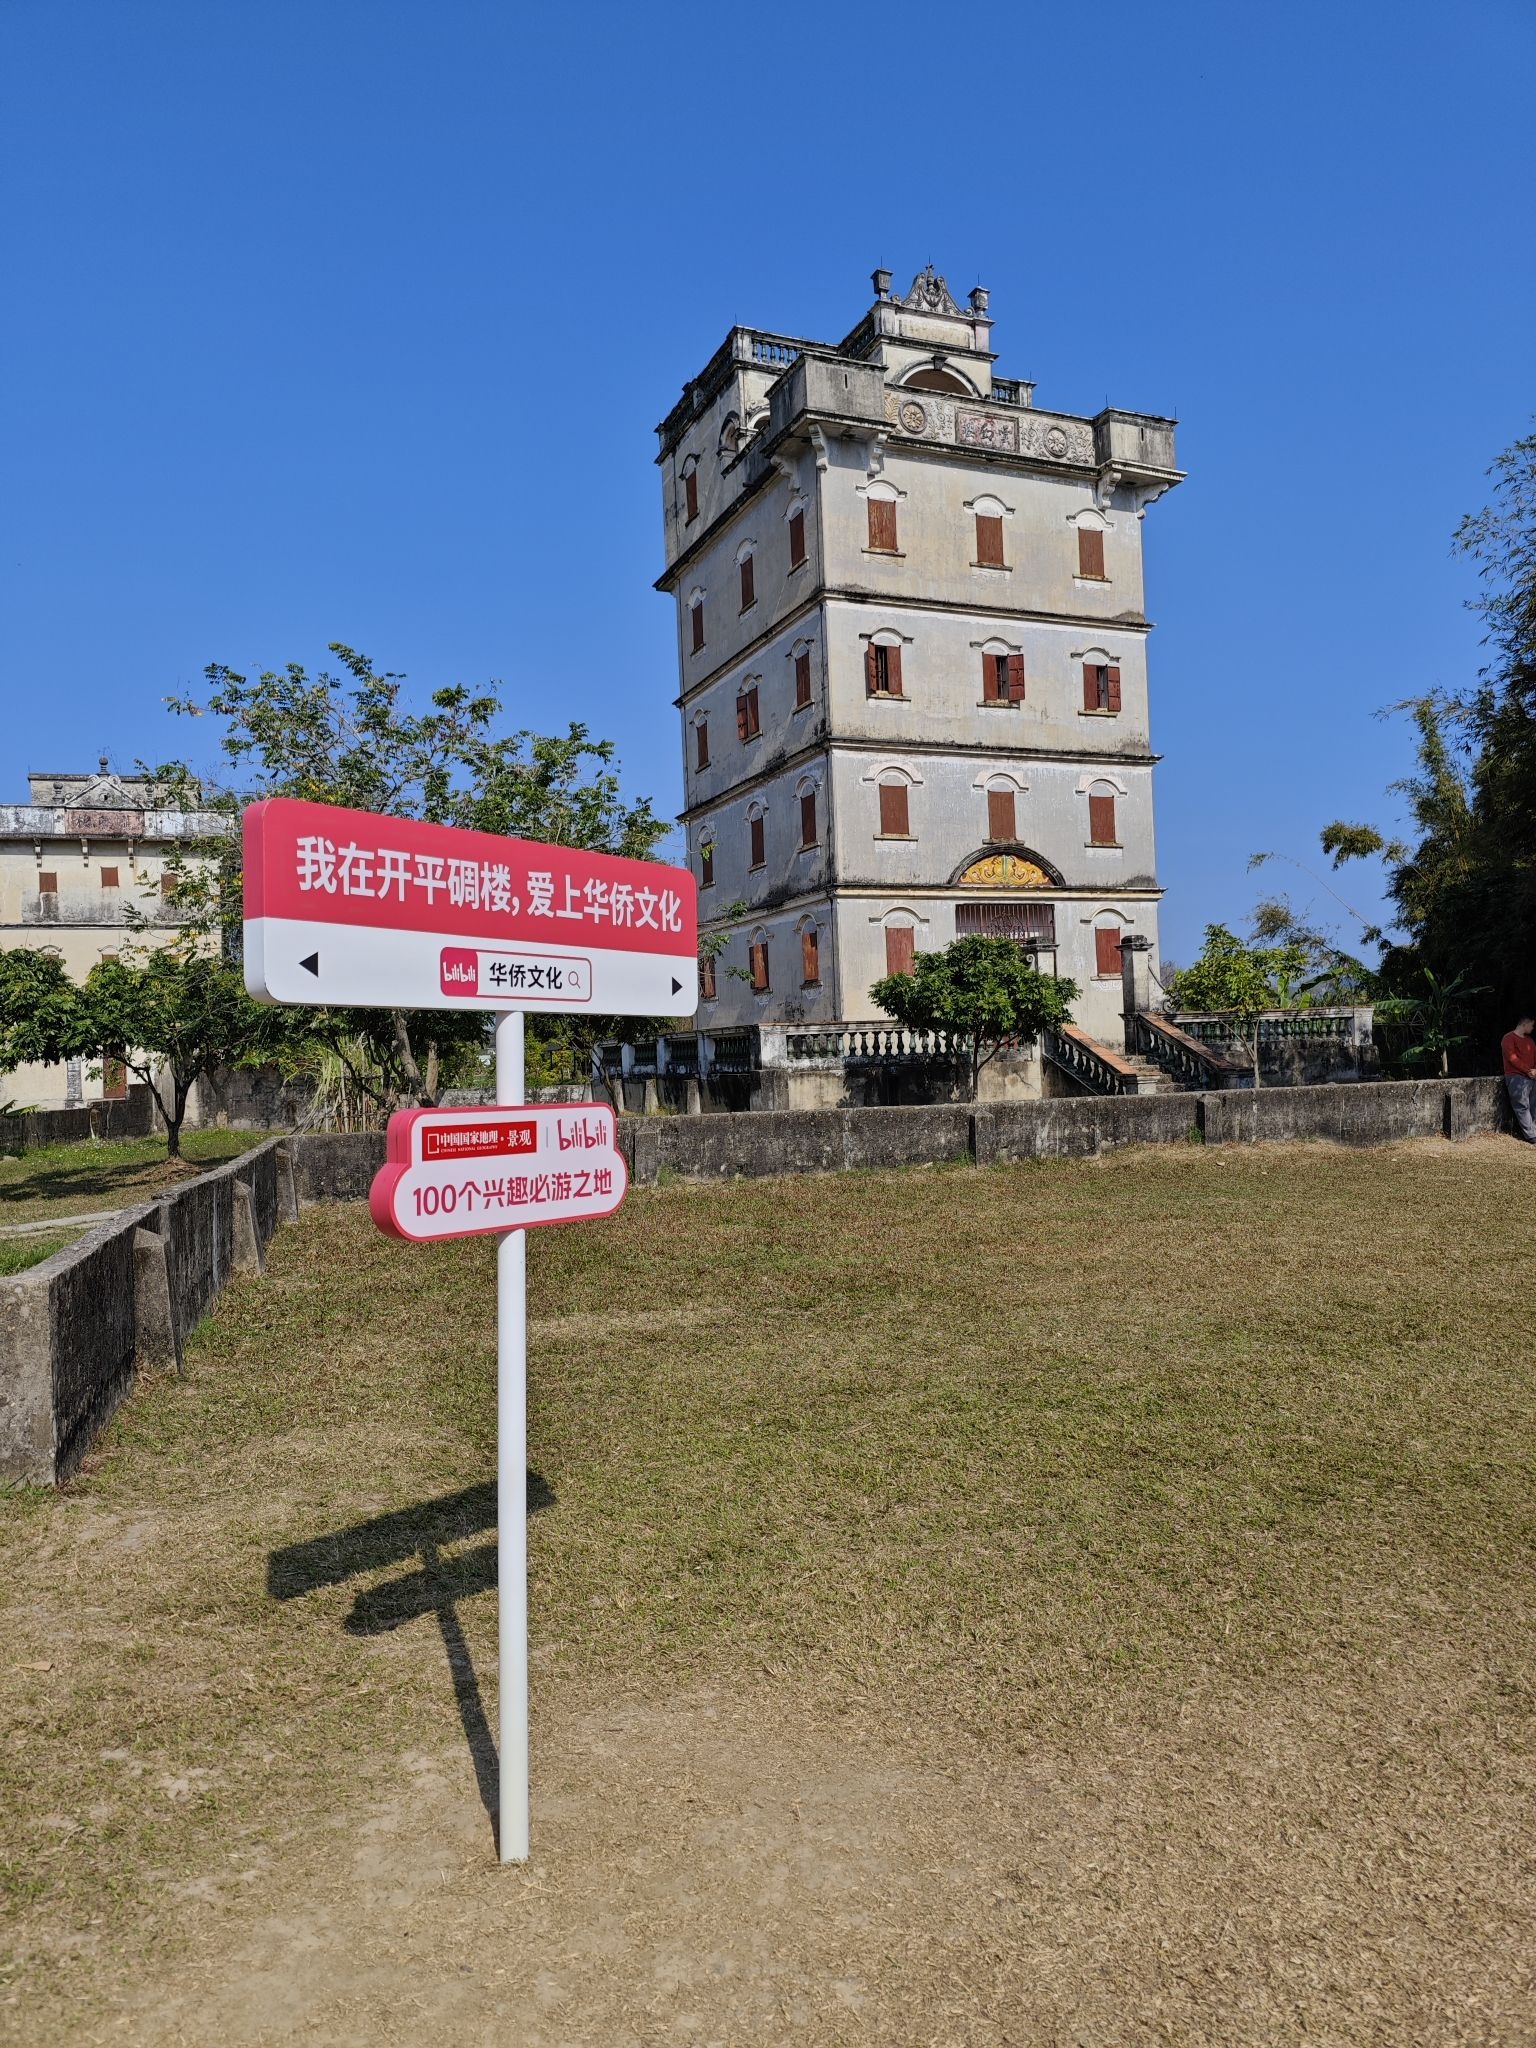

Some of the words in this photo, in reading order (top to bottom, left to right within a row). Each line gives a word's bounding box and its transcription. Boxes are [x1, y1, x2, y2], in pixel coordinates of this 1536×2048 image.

[442, 961, 476, 983] bilibili
[489, 962, 563, 990] 华侨文化
[557, 1117, 607, 1151] bilibili
[413, 1167, 613, 1217] 100个兴趣必游之地
